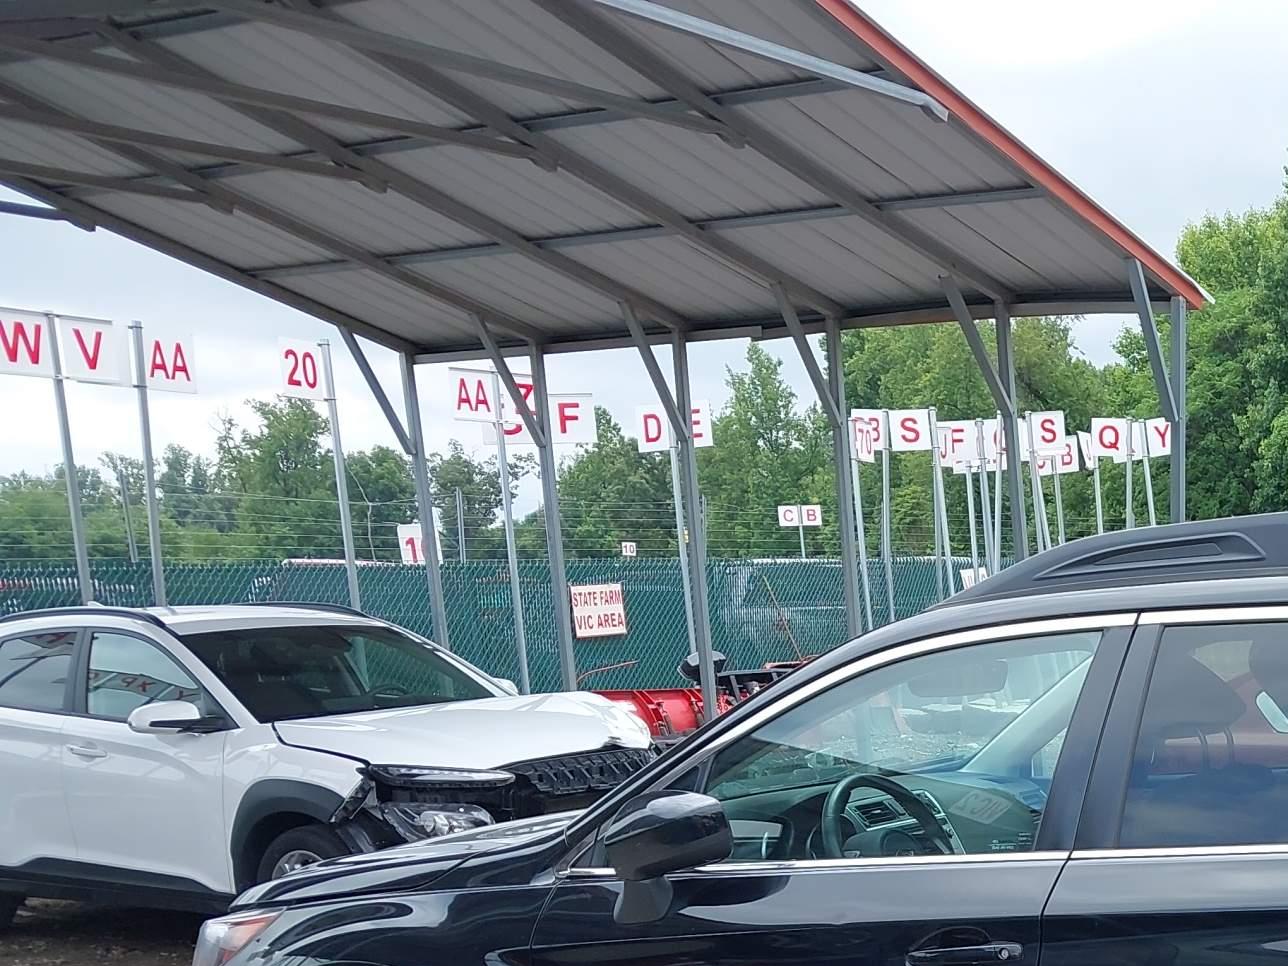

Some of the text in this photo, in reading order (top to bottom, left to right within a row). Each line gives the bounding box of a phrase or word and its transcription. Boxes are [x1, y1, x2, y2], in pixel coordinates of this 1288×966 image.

[0, 319, 41, 364] W
[72, 327, 102, 370] V
[150, 340, 191, 382] AA
[284, 348, 317, 389] 20
[456, 377, 491, 412] AA
[557, 402, 580, 434] F
[643, 413, 661, 443] D
[900, 417, 920, 443] S
[1040, 418, 1057, 443] S
[951, 428, 964, 454] F
[1099, 425, 1120, 450] Q
[1154, 424, 1170, 448] Y
[783, 509, 794, 522] C
[806, 509, 817, 522] B
[623, 544, 635, 554] 10
[573, 589, 622, 608] STATE FARM
[576, 612, 624, 630] VIC AREA
